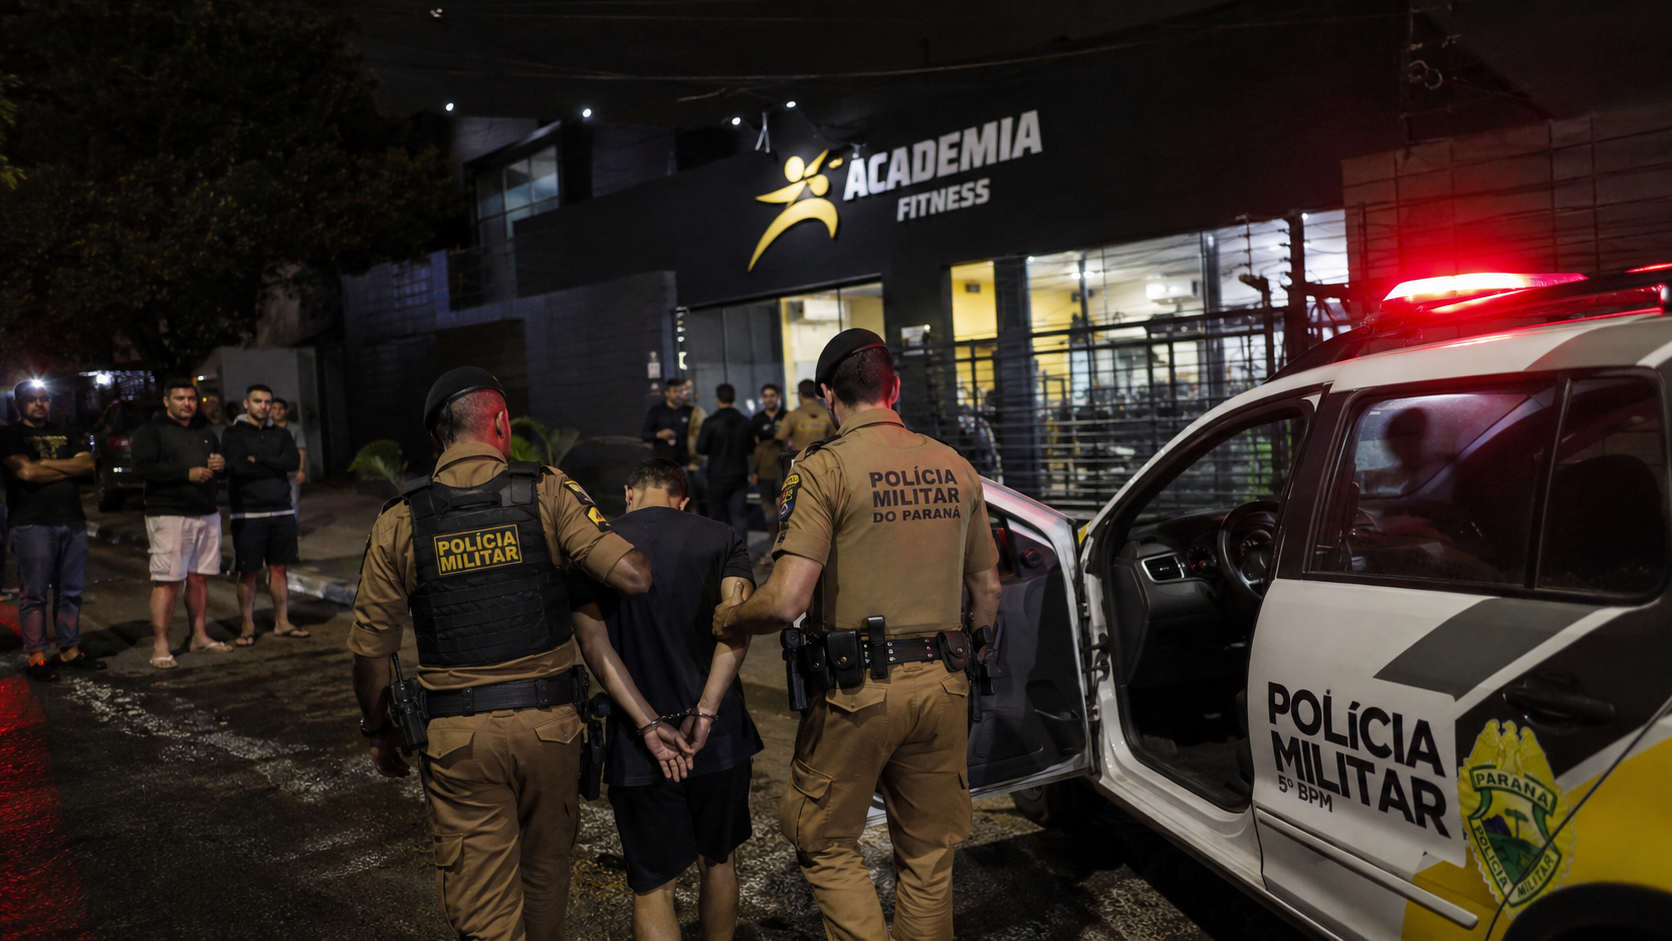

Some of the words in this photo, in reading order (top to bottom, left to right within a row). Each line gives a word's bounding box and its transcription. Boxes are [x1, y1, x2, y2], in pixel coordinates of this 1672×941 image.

[843, 109, 1043, 201] ACADEMIA
[897, 178, 990, 222] FITNESS
[869, 466, 958, 488] POLÍCIA
[872, 487, 960, 508] MILITAR
[902, 505, 961, 521] PARANÁ
[873, 511, 897, 523] DO
[437, 531, 517, 556] POLÍCIA
[440, 545, 519, 572] MILITAR
[1268, 681, 1447, 778] POLÍCIA
[1270, 729, 1452, 839] MILITAR
[1297, 781, 1333, 813] BPM
[1475, 773, 1549, 807] PARANA
[1474, 825, 1508, 893] POLICIA
[1517, 854, 1554, 898] MILITAR
